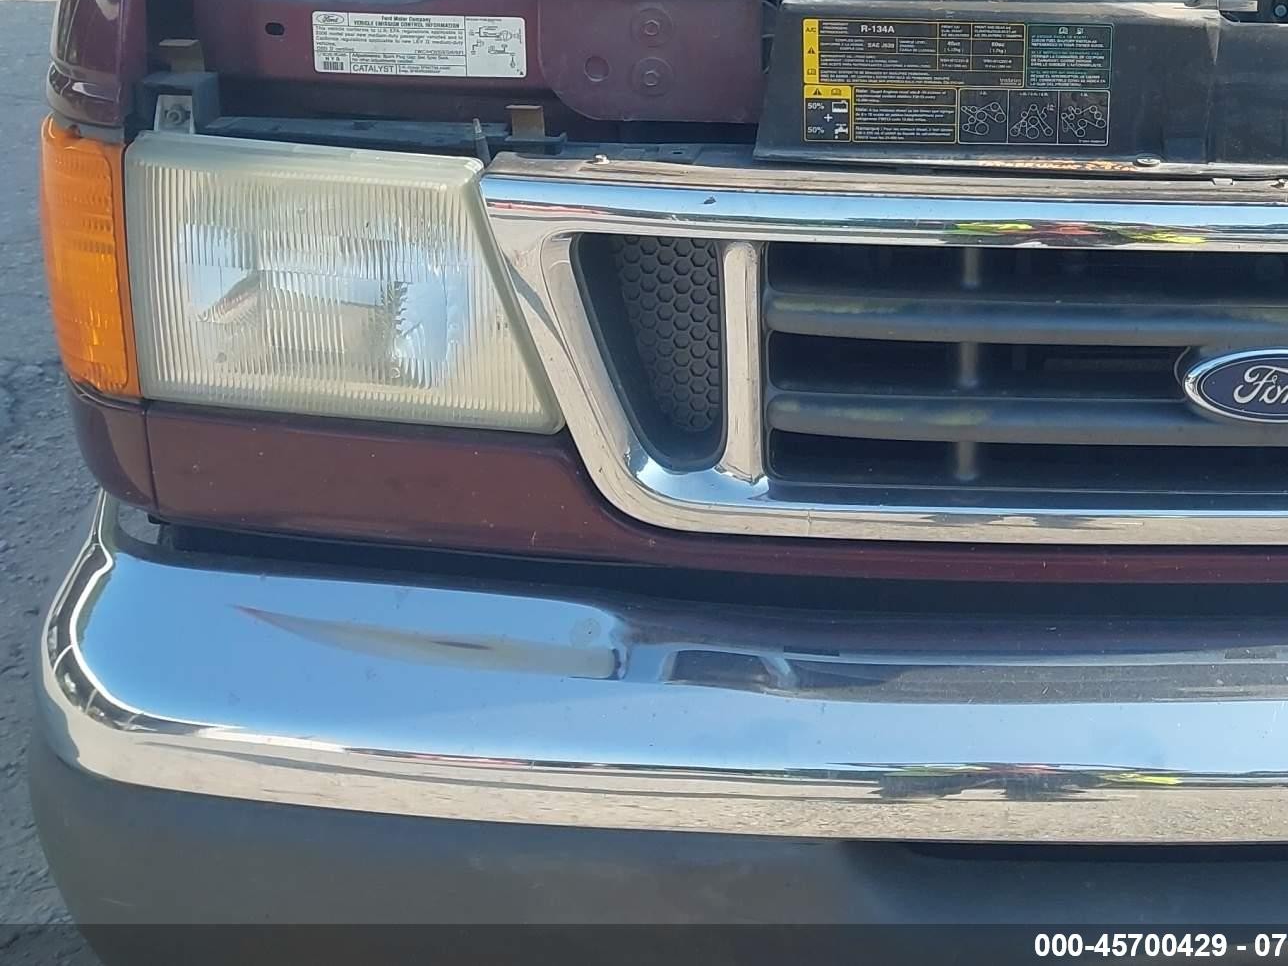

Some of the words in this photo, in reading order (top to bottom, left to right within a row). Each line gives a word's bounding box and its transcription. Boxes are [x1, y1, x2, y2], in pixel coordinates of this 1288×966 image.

[860, 25, 895, 33] R-134A
[352, 64, 395, 73] CATALYST
[808, 102, 825, 110] 50%
